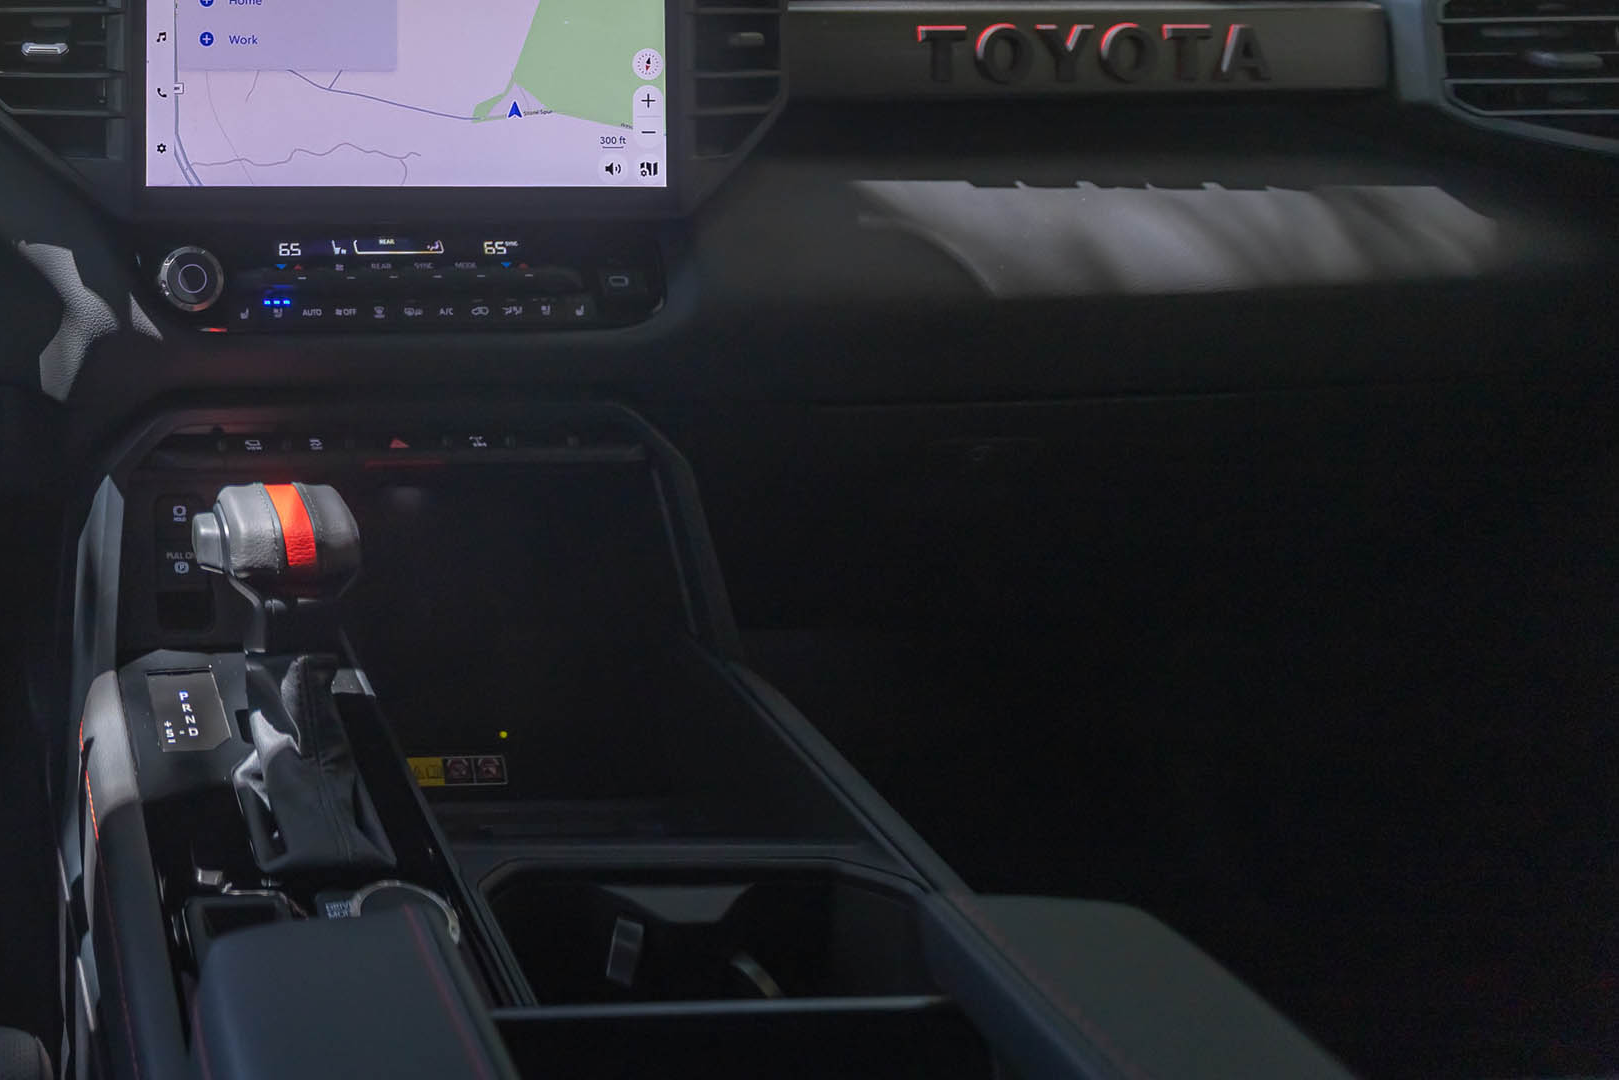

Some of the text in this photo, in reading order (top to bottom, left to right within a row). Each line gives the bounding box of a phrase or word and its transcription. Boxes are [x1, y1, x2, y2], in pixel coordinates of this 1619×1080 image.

[229, 34, 258, 45] Work
[917, 22, 1271, 84] TOYOTA
[600, 135, 627, 145] 300 ft
[278, 242, 302, 256] 65
[483, 240, 507, 255] 65
[302, 308, 323, 317] AUTO
[342, 308, 358, 316] OFF
[439, 307, 454, 316] A/C
[178, 690, 189, 701] P
[181, 703, 193, 713] R
[184, 714, 197, 725] N
[188, 727, 199, 737] D
